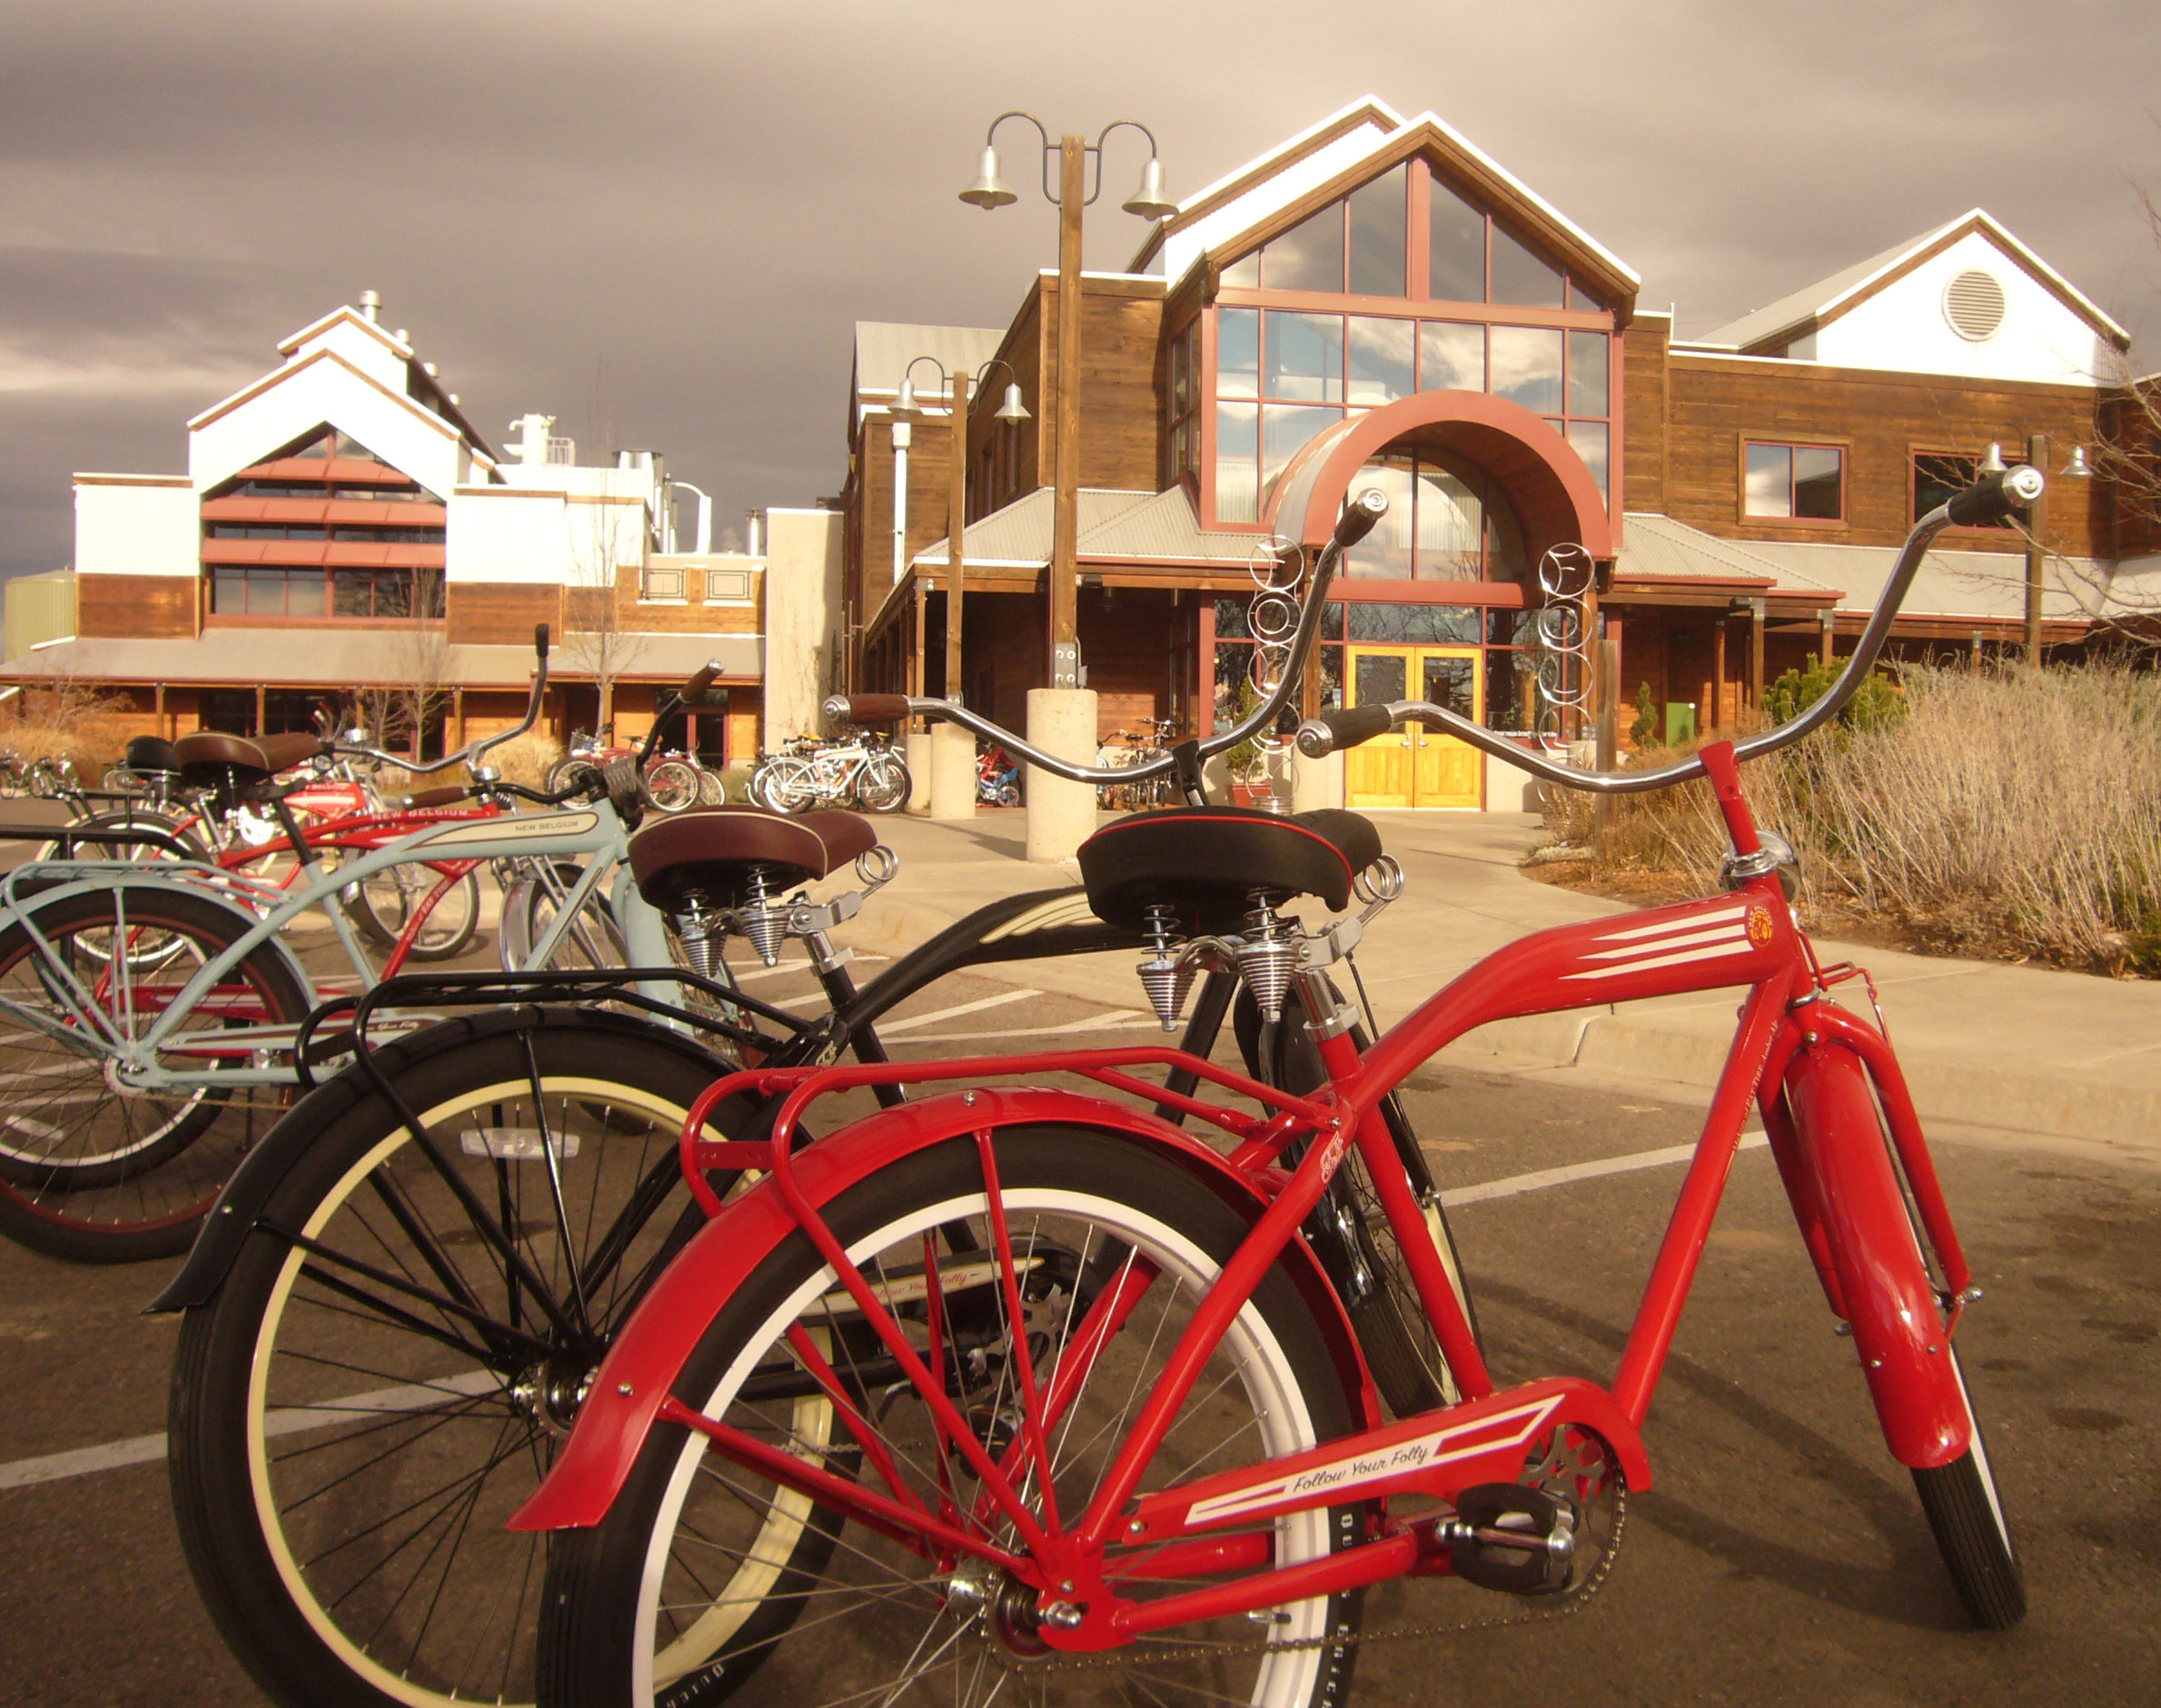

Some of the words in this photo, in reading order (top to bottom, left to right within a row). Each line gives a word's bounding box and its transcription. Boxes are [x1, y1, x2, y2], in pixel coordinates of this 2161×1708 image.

[372, 810, 401, 820] NEW
[408, 808, 469, 818] BELGIUM
[539, 820, 579, 830] BELGIUM
[1294, 1470, 1346, 1493] Follow
[1352, 1459, 1387, 1476] Your
[1391, 1445, 1429, 1465] Folly
